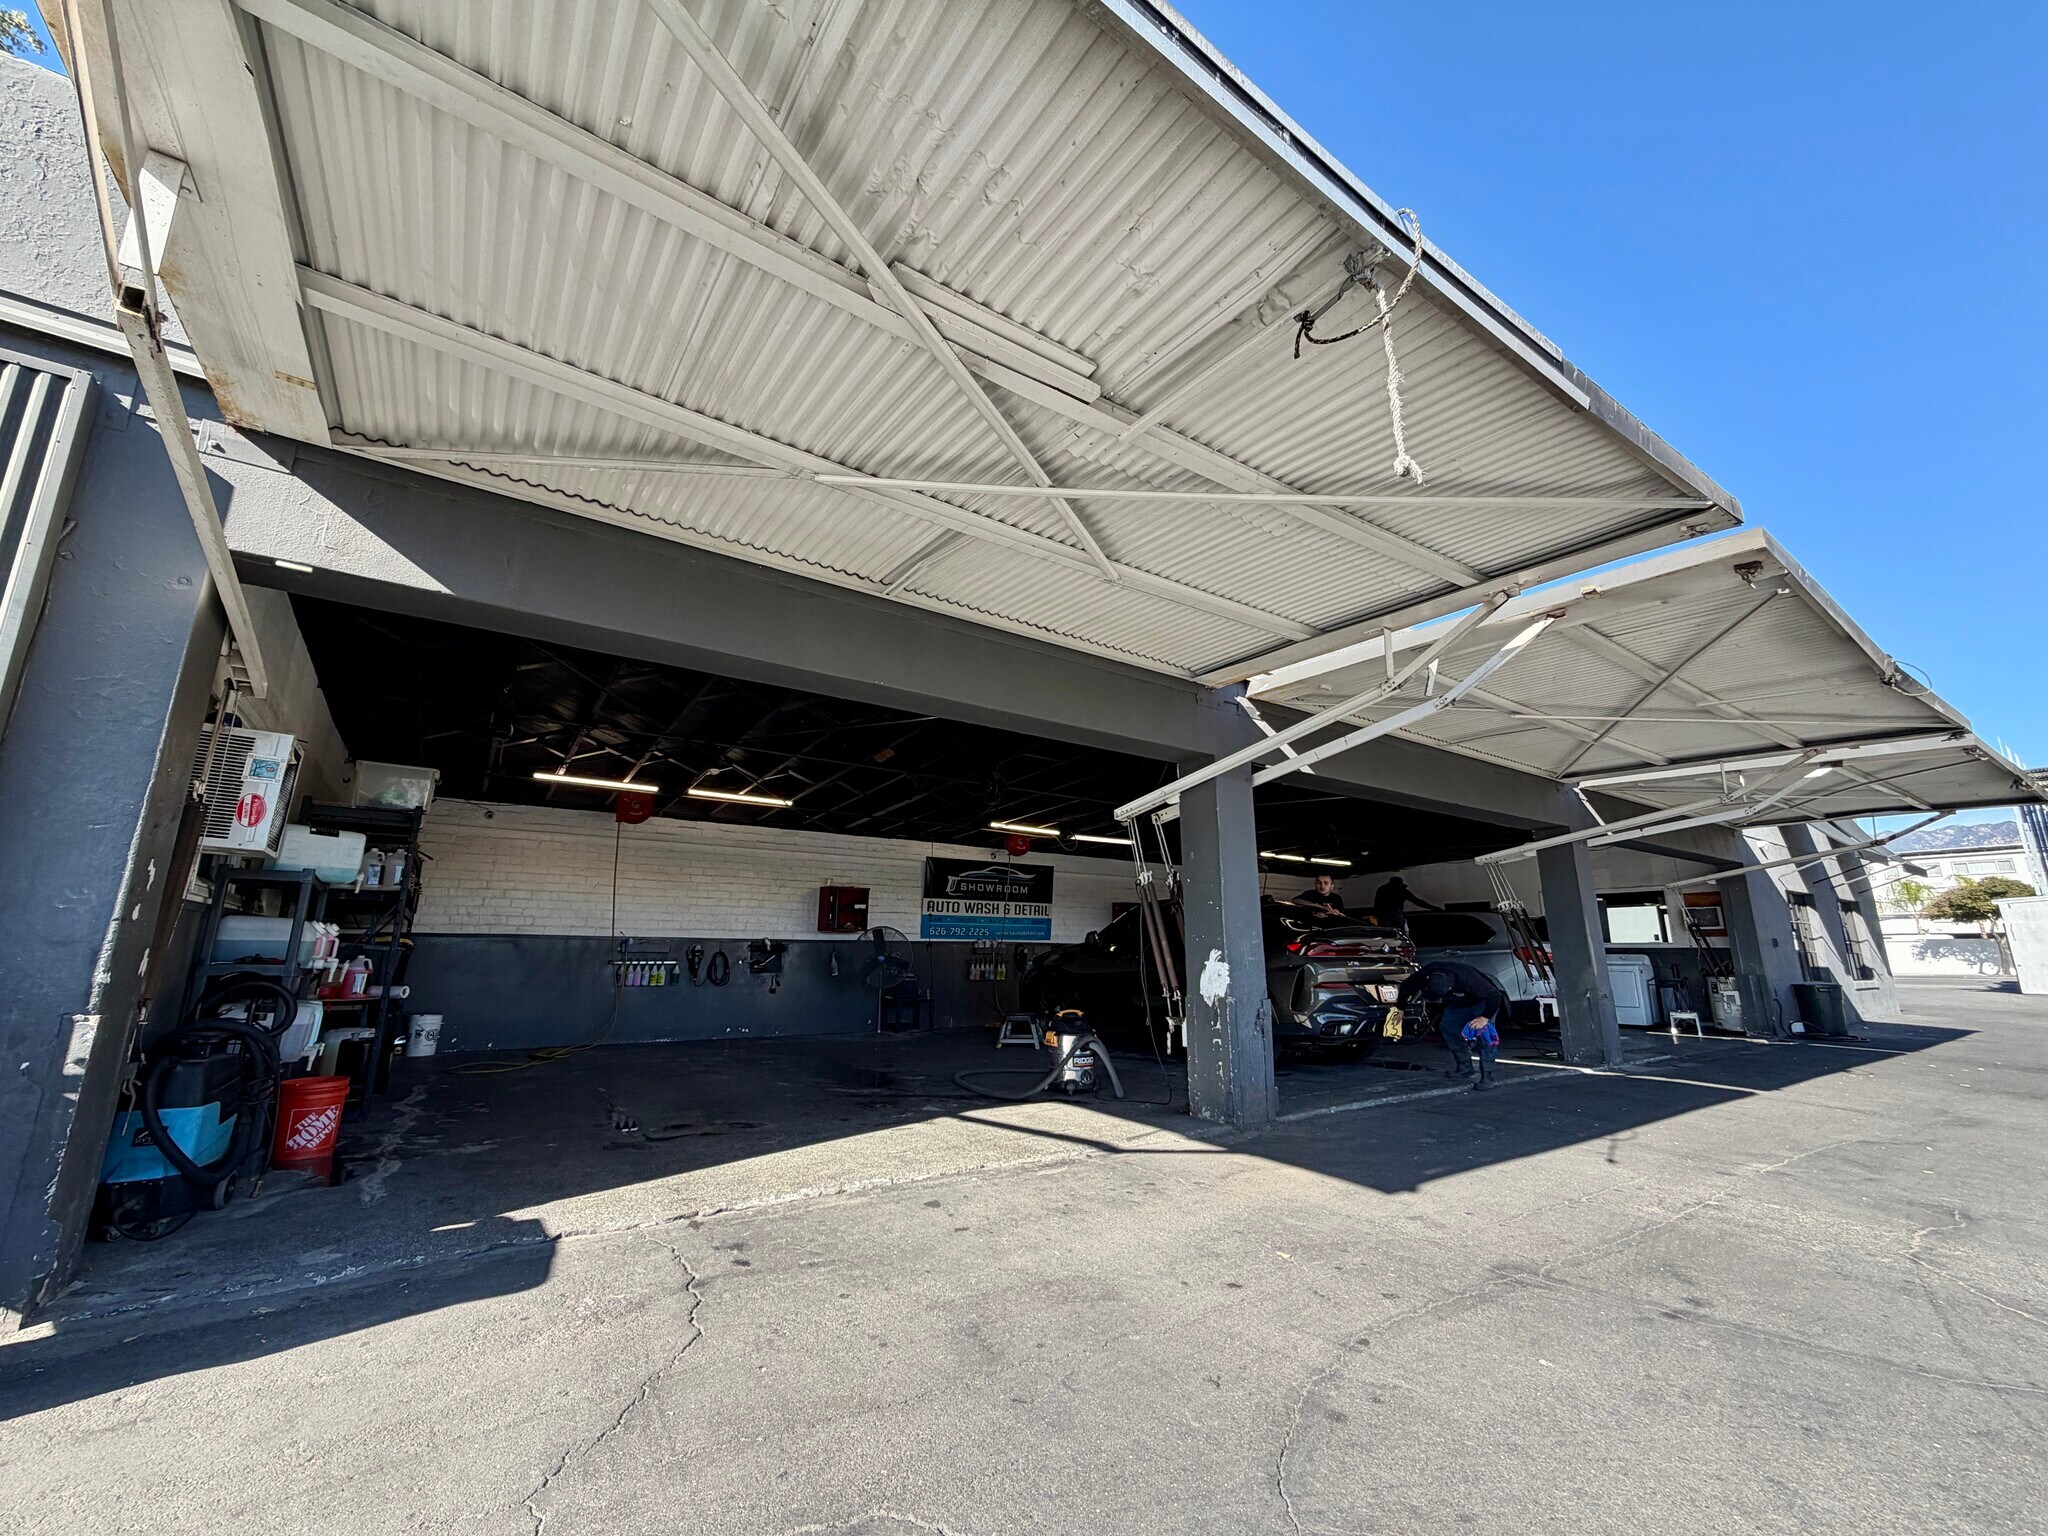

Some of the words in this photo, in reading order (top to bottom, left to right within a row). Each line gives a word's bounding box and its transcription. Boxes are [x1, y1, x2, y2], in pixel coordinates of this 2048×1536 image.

[960, 882, 1029, 894] SHOWROOM
[927, 901, 960, 912] AUTO
[964, 902, 999, 915] WASH
[1003, 904, 1010, 915] &
[1014, 904, 1050, 916] DETAIL
[288, 1106, 338, 1150] HOME
[295, 1112, 319, 1130] THE
[306, 1121, 336, 1150] DEPOT
